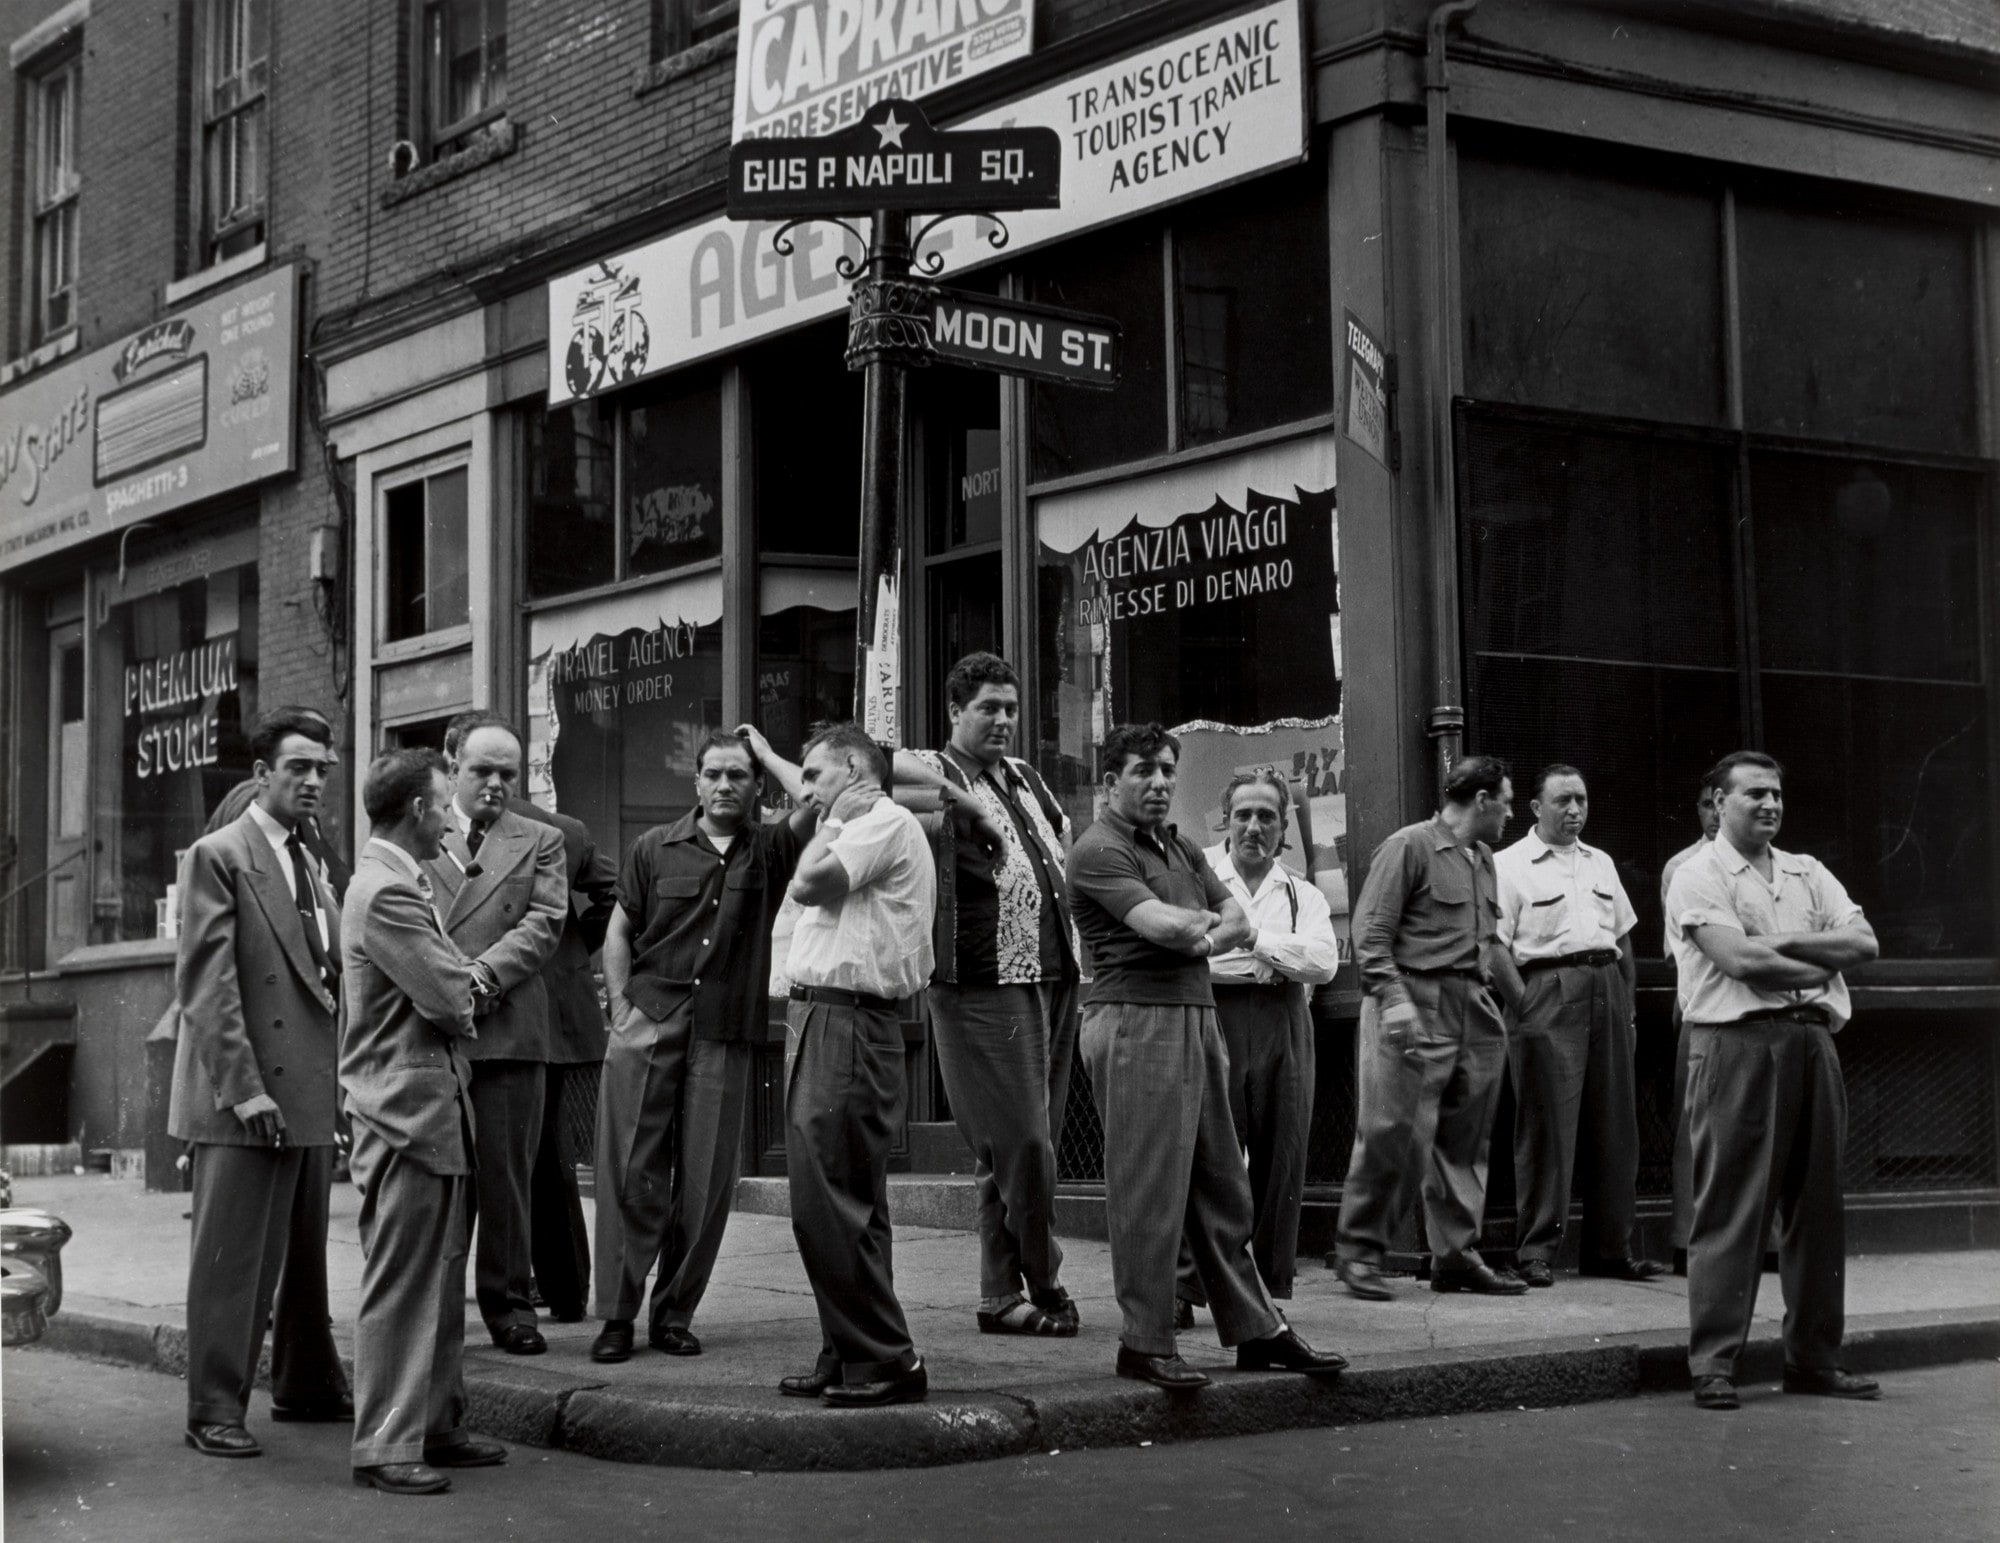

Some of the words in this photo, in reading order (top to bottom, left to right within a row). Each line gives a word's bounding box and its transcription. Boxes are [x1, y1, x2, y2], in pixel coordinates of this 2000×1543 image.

[748, 0, 1012, 114] CAPRA
[1067, 19, 1280, 124] TRANSOCEANIC
[1074, 96, 1183, 161] TOURIST
[1191, 55, 1280, 127] TRAVEL
[743, 158, 807, 192] GUS
[818, 156, 836, 189] P.
[846, 152, 952, 187] NAPOLI
[981, 149, 1034, 185] SQ.
[1109, 122, 1231, 193] AGENCY
[935, 308, 1042, 360] MOON
[1061, 333, 1111, 371] ST.
[1083, 525, 1190, 584] AGENZIA
[1201, 504, 1287, 560] VIAGGI
[1079, 583, 1166, 627] RIMESSE
[1176, 580, 1195, 608] DI
[1206, 558, 1292, 603] DENARO
[124, 638, 238, 716] PREMIUM
[554, 640, 619, 685] TRAVEL
[628, 621, 698, 669] AGENCY
[574, 683, 621, 714] MONEY
[627, 673, 673, 704] ORDER
[137, 712, 219, 778] STORE
